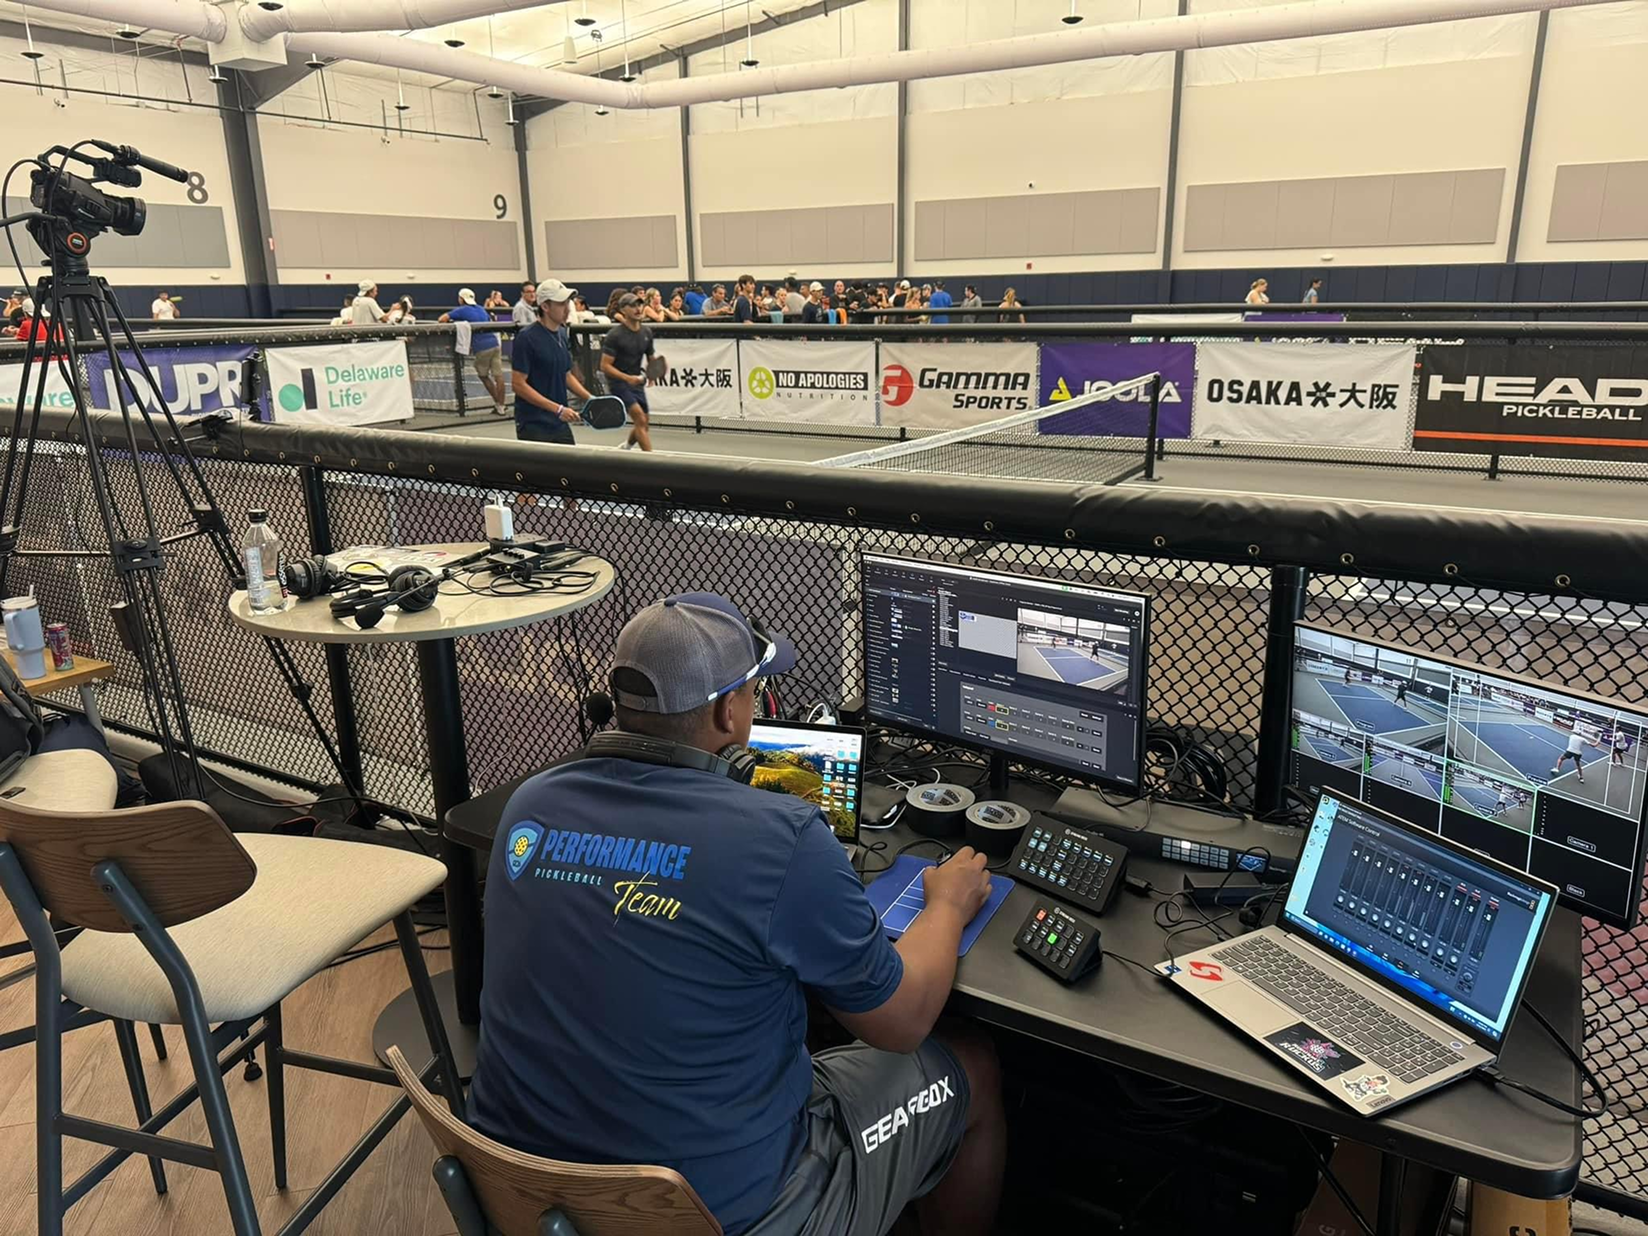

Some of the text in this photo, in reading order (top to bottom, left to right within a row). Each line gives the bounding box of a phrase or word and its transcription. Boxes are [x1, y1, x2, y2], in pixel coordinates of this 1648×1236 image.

[187, 171, 208, 204] 8
[493, 194, 508, 220] 9
[103, 360, 242, 414] DUPR
[325, 364, 405, 385] Delaware
[699, 368, 733, 388] 大阪
[778, 372, 865, 389] NO APOLOGIES
[776, 391, 868, 401] NUTRITION
[952, 393, 1029, 411] SPORTS
[1207, 378, 1303, 407] OSAKA
[1338, 381, 1400, 411] 大阪
[1426, 374, 1648, 406] HEAD
[1502, 404, 1643, 421] PICKLEBALL
[540, 829, 692, 880] PERFORMANCE
[534, 867, 603, 887] PICKLEBALL
[612, 871, 682, 928] Team
